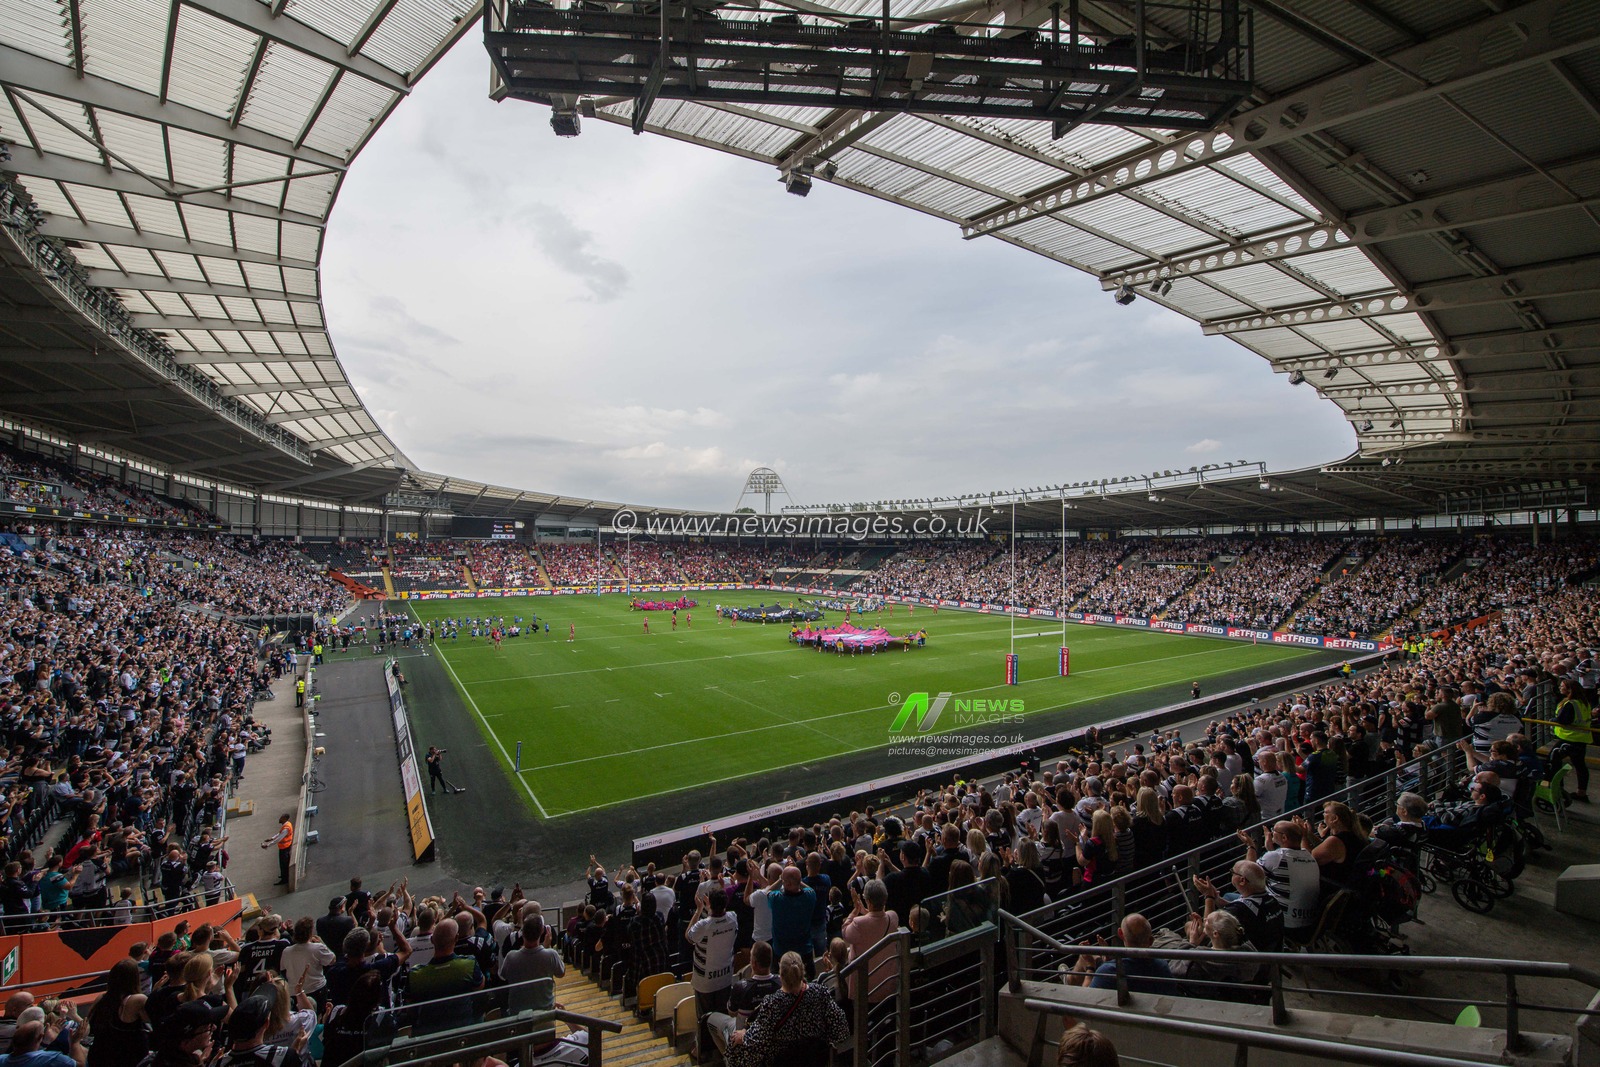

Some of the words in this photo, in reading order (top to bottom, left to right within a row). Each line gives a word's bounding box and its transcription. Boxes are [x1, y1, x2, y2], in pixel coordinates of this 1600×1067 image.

[636, 838, 662, 850] planning
[252, 958, 266, 974] 4
[708, 966, 730, 980] SOLITA
